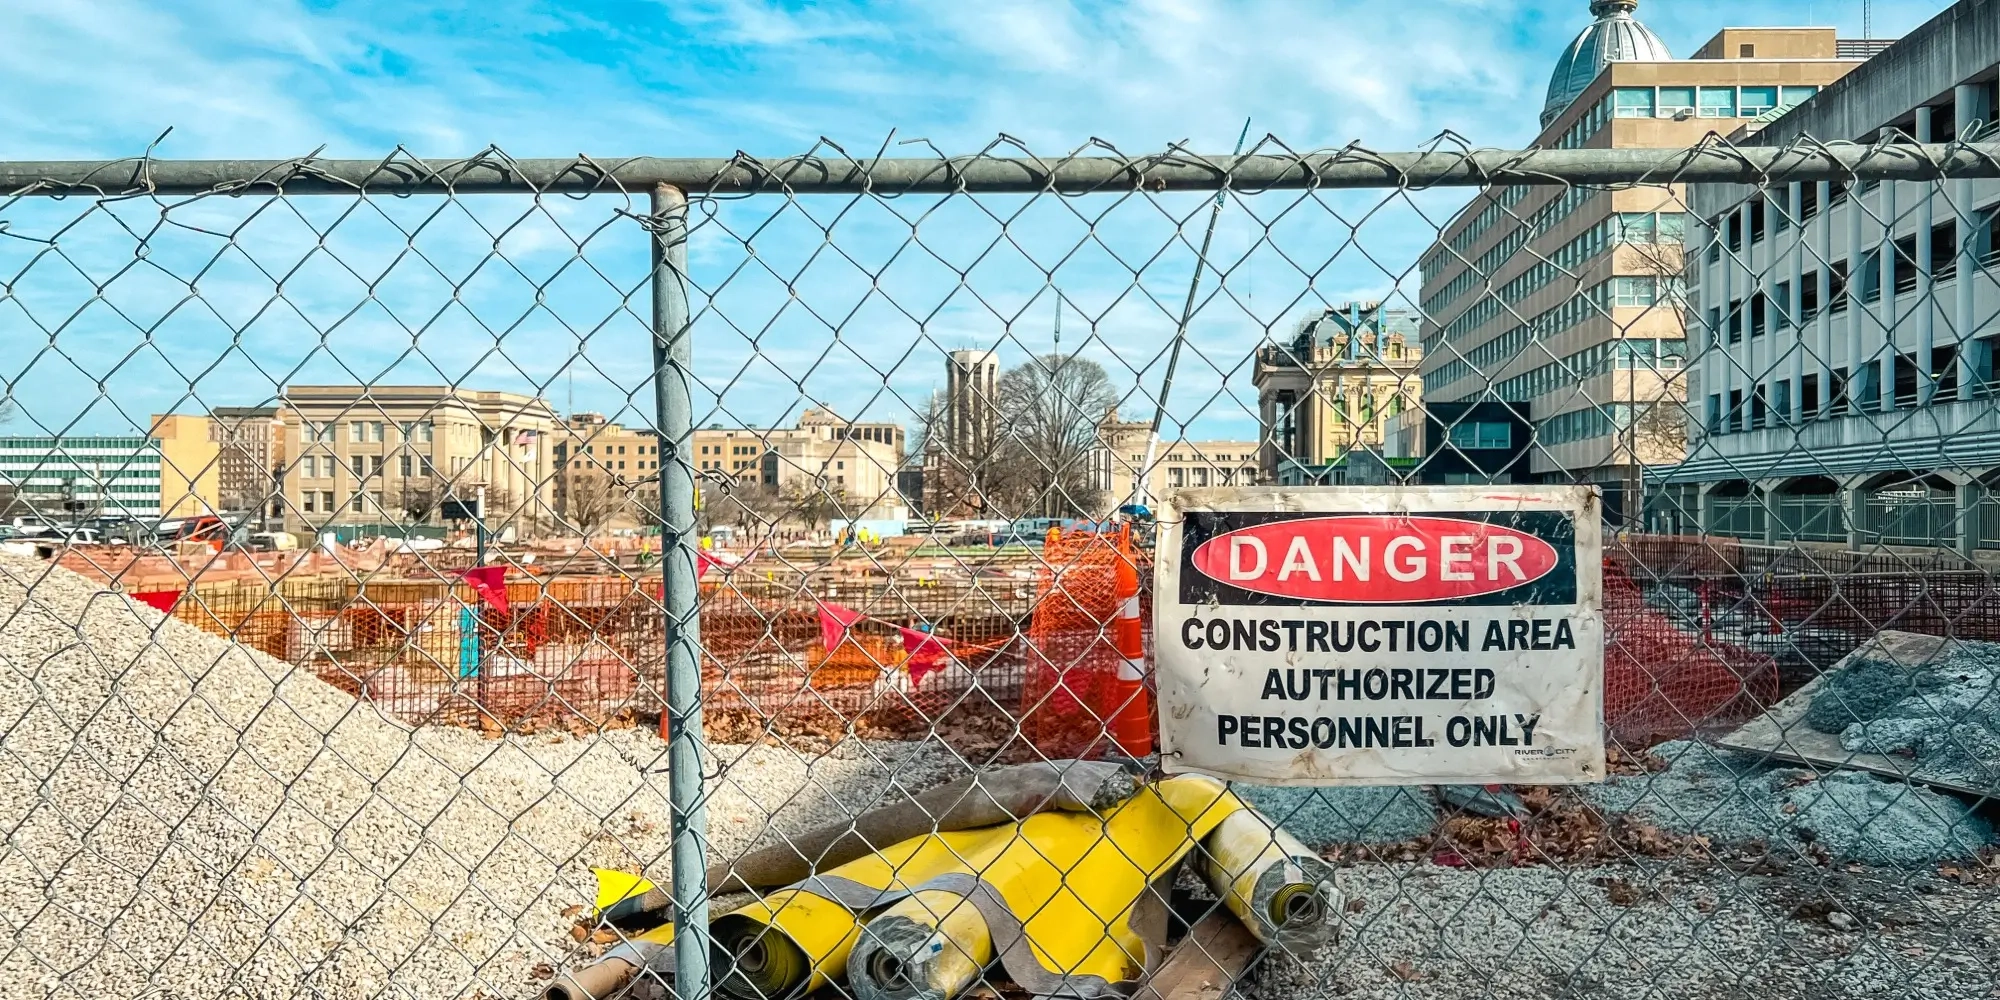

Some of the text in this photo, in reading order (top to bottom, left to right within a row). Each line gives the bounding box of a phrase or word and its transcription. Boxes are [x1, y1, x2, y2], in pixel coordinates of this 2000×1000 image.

[1229, 535, 1527, 582] DANGER
[1181, 617, 1576, 653] CONSTRUCTION AREA
[1260, 668, 1496, 701] AUTHORIZED
[1217, 714, 1541, 750] PERSONNEL ONLY
